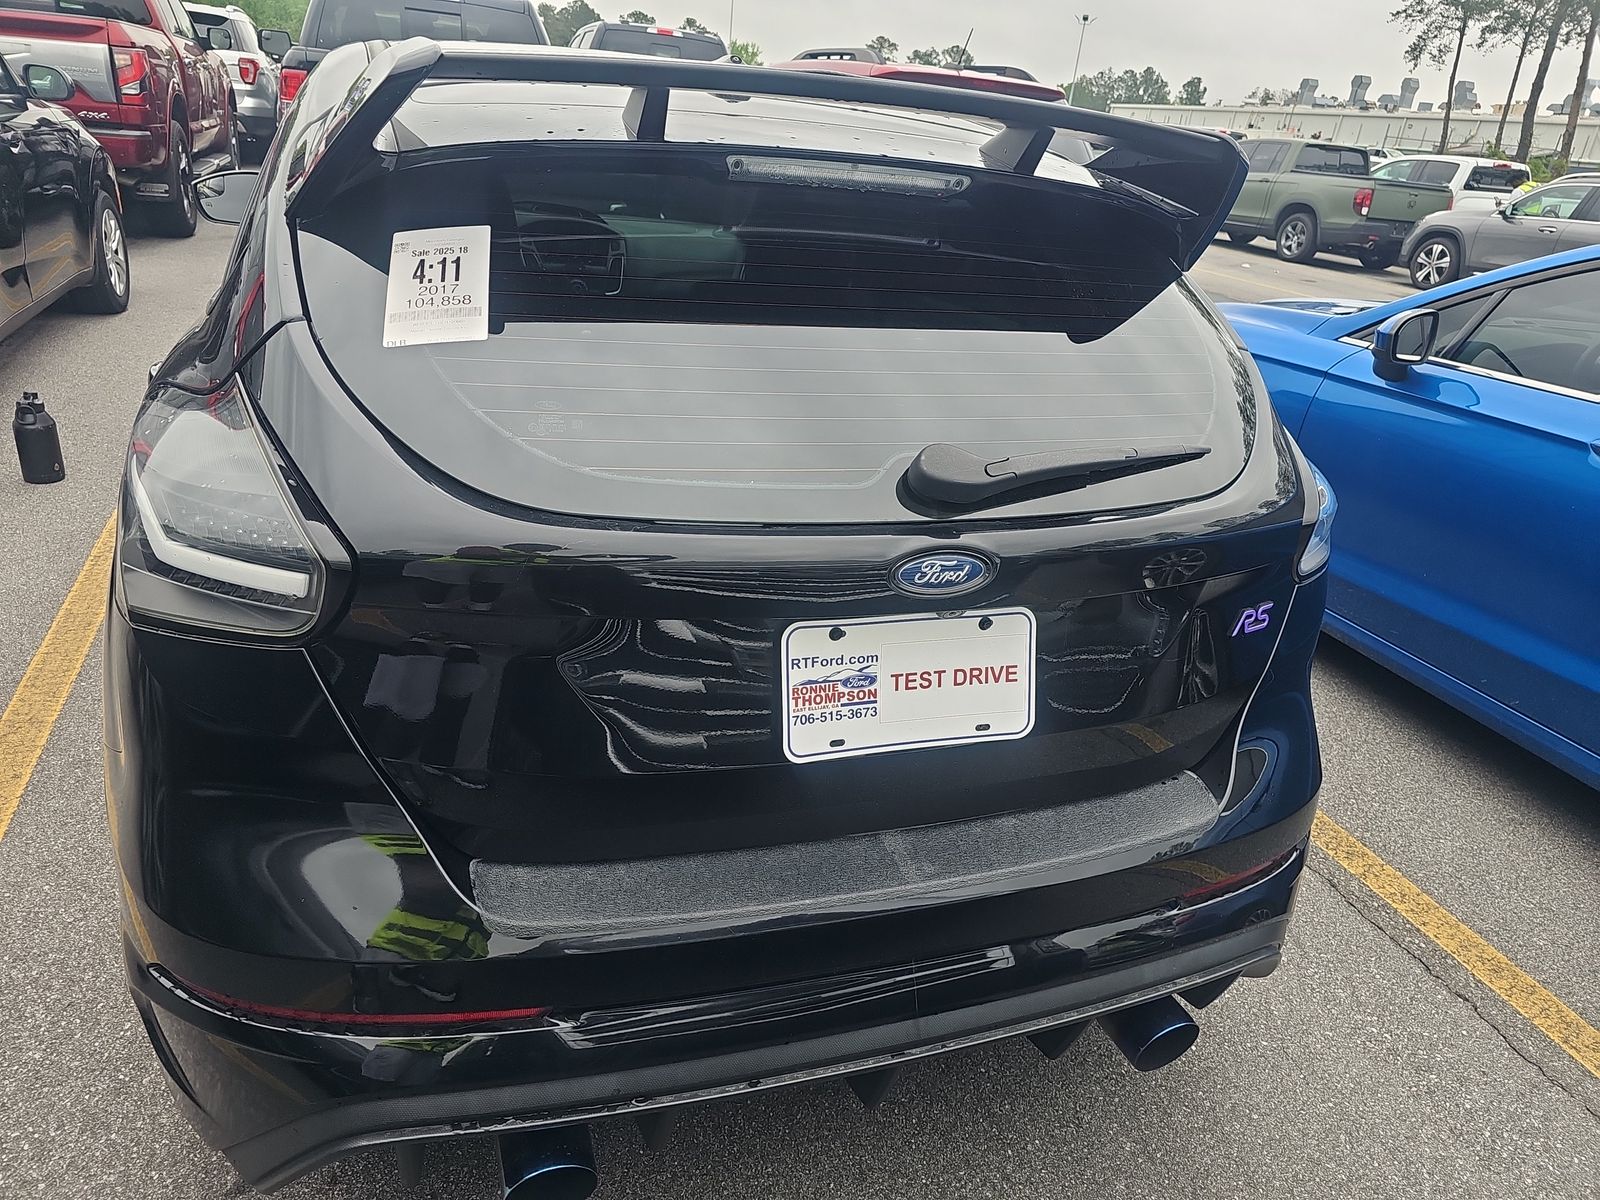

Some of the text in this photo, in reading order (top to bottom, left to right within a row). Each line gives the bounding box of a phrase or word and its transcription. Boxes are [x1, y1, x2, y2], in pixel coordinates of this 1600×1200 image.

[411, 246, 469, 258] Sale 2025 18
[412, 256, 461, 284] 4:11
[418, 283, 459, 296] 2017
[406, 294, 472, 309] 104,858
[914, 559, 972, 584] Ford
[1231, 600, 1275, 638] RS
[791, 654, 879, 670] RTFord.com
[847, 676, 871, 687] Ford
[890, 664, 1019, 692] TEST DRIVE
[792, 683, 839, 697] RONNIE
[792, 688, 878, 708] THOMPSON
[792, 706, 878, 726] 706-515-3673
